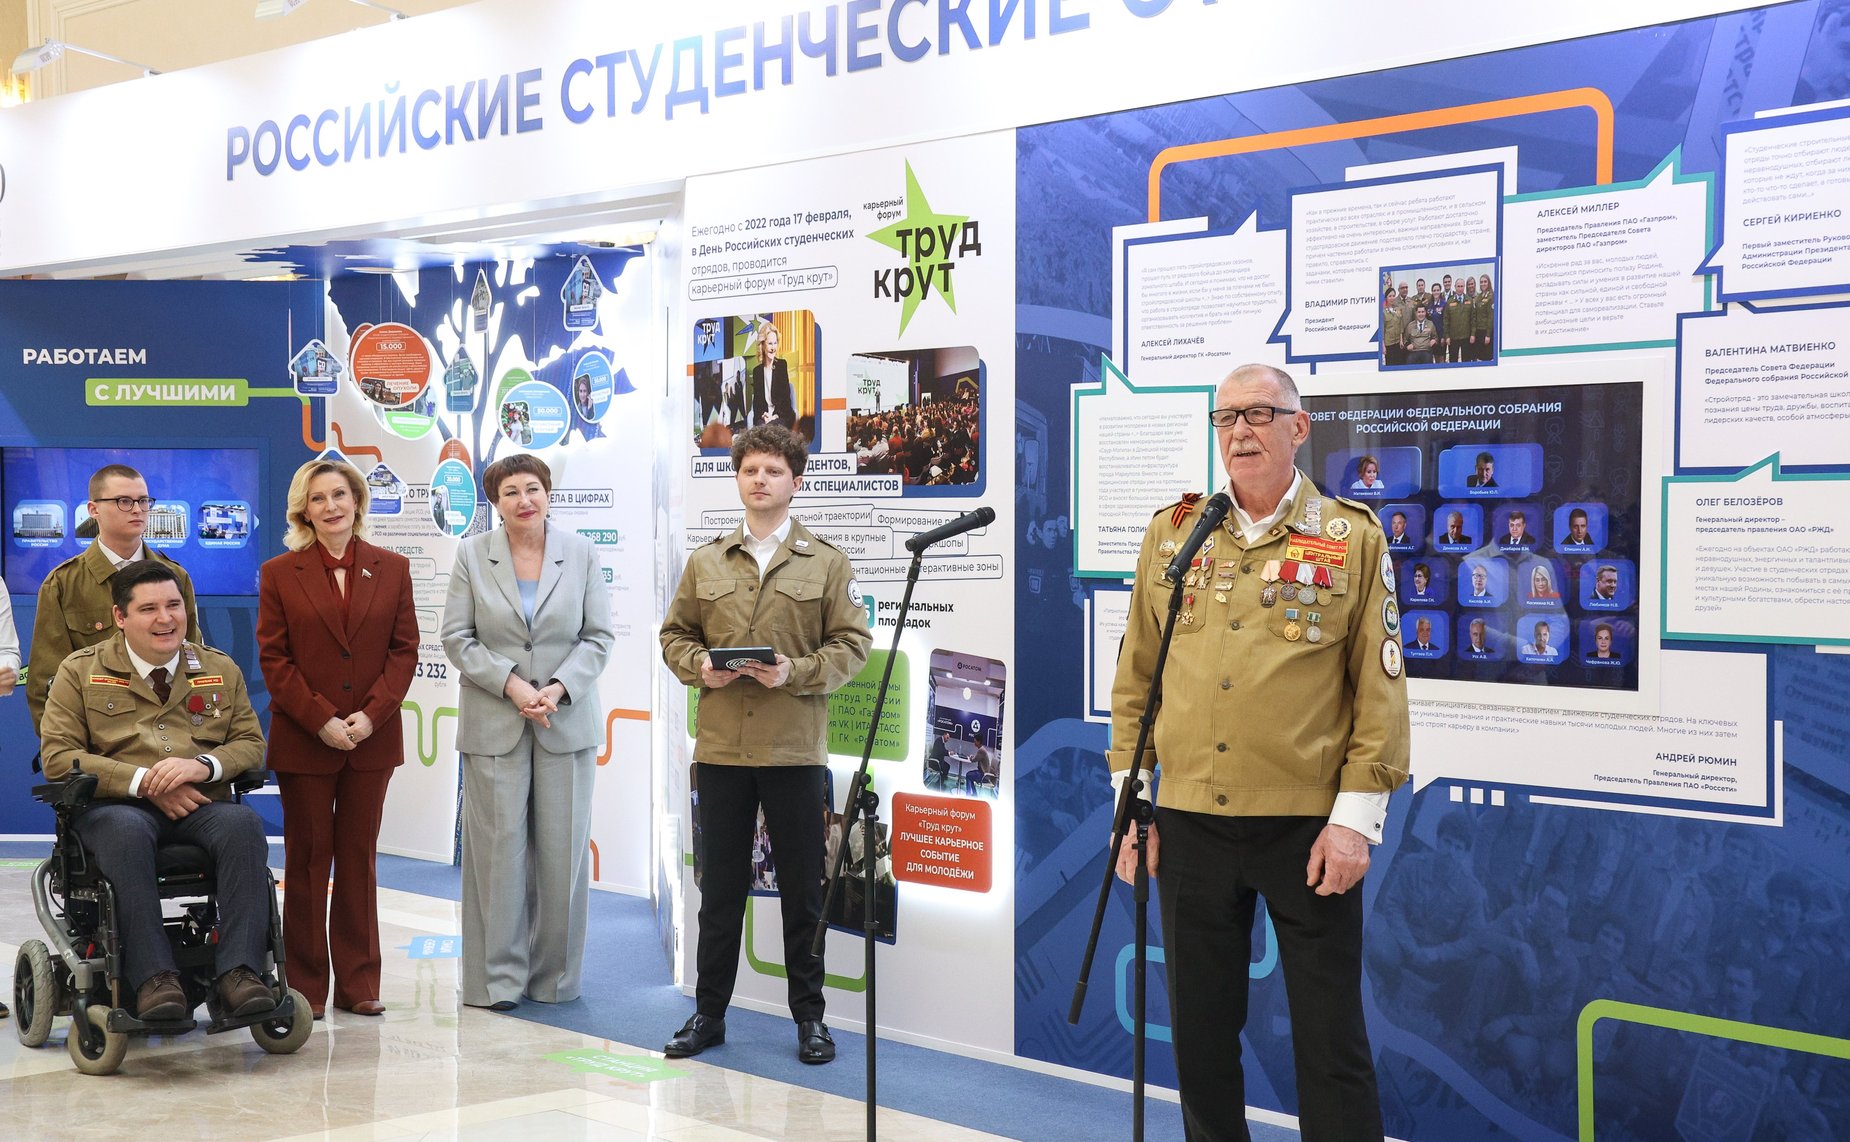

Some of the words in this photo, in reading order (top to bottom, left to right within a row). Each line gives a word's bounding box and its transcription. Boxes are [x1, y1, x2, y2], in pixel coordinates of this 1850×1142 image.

[226, 67, 543, 180] РОССИЙСКИЕ
[863, 197, 903, 211] карьерный
[1537, 205, 1578, 218] АЛЕКСЕЙ
[1581, 202, 1619, 214] МИЛЛЕР
[877, 210, 901, 221] форум
[1743, 214, 1781, 227] СЕРГЕЙ
[1785, 209, 1841, 223] КИРИЕНКО
[692, 225, 735, 237] Ежегодно
[737, 223, 743, 231] с
[745, 218, 766, 230] 2022
[769, 216, 790, 227] года
[794, 213, 802, 224] 17
[805, 210, 851, 225] февраля,
[1537, 224, 1583, 234] Председатель
[1584, 220, 1621, 230] Правления
[1622, 217, 1639, 225] ПАО
[896, 221, 981, 262] труд
[1537, 234, 1577, 243] заместитель
[1579, 229, 1626, 239] Председателя
[1742, 241, 1771, 250] Первый
[1773, 237, 1821, 247] заместитель
[1823, 234, 1850, 244] Руково
[692, 248, 696, 256] в
[699, 244, 722, 257] День
[725, 237, 781, 252] Российских
[784, 229, 854, 247] студенческих
[1536, 244, 1574, 253] директоров
[1742, 250, 1803, 260] Администрации
[692, 263, 730, 276] отрядов,
[732, 256, 787, 272] проводится
[1742, 260, 1785, 270] Российской
[1788, 258, 1832, 267] Федерации
[692, 279, 741, 296] карьерный
[745, 277, 774, 291] форум
[778, 274, 804, 289] «Труд
[807, 271, 832, 287] крут»
[874, 262, 954, 302] крут
[1305, 299, 1348, 308] ВЛАДИМИР
[1350, 296, 1376, 306] ПУТИН
[1305, 317, 1334, 325] Президент
[1305, 325, 1337, 333] Российской
[1339, 323, 1370, 331] Федерации
[1141, 338, 1171, 348] АЛЕКСЕЙ
[1173, 336, 1205, 346] ЛИХАЧЁВ
[1705, 346, 1767, 357] ВАЛЕНТИНА
[1770, 342, 1836, 353] МАТВИЕНКО
[23, 349, 147, 364] РАБОТАЕМ
[1705, 366, 1758, 375] Председатель
[1761, 364, 1787, 372] Совета
[1789, 361, 1835, 370] Федерации
[863, 378, 880, 388] труд
[1705, 376, 1759, 385] Федерального
[1761, 374, 1798, 382] собрания
[1801, 371, 1848, 380] Российской
[95, 385, 110, 400] С
[116, 384, 235, 401] ЛУЧШИМИ
[858, 386, 876, 395] крут
[1756, 394, 1770, 402] это
[1771, 392, 1828, 401] замечательная
[1339, 409, 1403, 421] ФЕДЕРАЦИИ
[1407, 405, 1495, 419] ФЕДЕРАЛЬНОГО
[1499, 402, 1561, 415] СОБРАНИЯ
[1741, 405, 1760, 413] цены
[1704, 416, 1743, 424] лидерских
[1777, 413, 1804, 421] особой
[1357, 421, 1428, 434] РОССИЙСКОЙ
[1431, 419, 1501, 432] ФЕДЕРАЦИИ
[695, 462, 713, 474] ДЛЯ
[807, 459, 850, 472] ДЕНТОВ,
[814, 480, 898, 492] СПЕЦИАЛИСТОВ
[550, 494, 566, 503] ЕЛА
[568, 494, 573, 503] В
[576, 494, 609, 504] ЦИФРАХ
[1696, 498, 1720, 506] ОЛЕГ
[1724, 496, 1783, 506] БЕЛОЗЁРОВ
[705, 517, 745, 526] Построени
[825, 511, 870, 522] траектории
[878, 514, 942, 529] Формирование
[1744, 516, 1781, 524] директор
[1097, 525, 1127, 533] ТАТЬЯНА
[1746, 526, 1788, 534] правления
[1788, 526, 1807, 534] ОАО
[603, 532, 616, 541] 290
[844, 534, 850, 542] в
[852, 534, 886, 543] крупные
[852, 565, 906, 577] ентационные
[977, 562, 999, 571] зоны
[878, 600, 954, 613] регинальных
[878, 617, 931, 629] плоадок
[829, 694, 860, 703] интруд
[839, 706, 855, 716] ПАО
[839, 720, 849, 729] VK
[1699, 719, 1738, 727] ключевых
[839, 734, 849, 743] ГК
[1656, 752, 1695, 763] АНДРЕЙ
[1698, 756, 1737, 766] РЮМИН
[1653, 769, 1699, 780] Генеральный
[1594, 774, 1641, 785] Председатель
[1643, 778, 1681, 788] Правления
[905, 803, 948, 816] Карьерный
[950, 809, 976, 821] форум
[900, 832, 933, 844] ЛУЧШЕЕ
[935, 837, 984, 850] КАРЬЕРНОЕ
[920, 850, 960, 862] СОБЫТИЕ
[906, 862, 923, 872] ДЛЯ
[925, 865, 974, 879] МОЛОДЁЖИ
